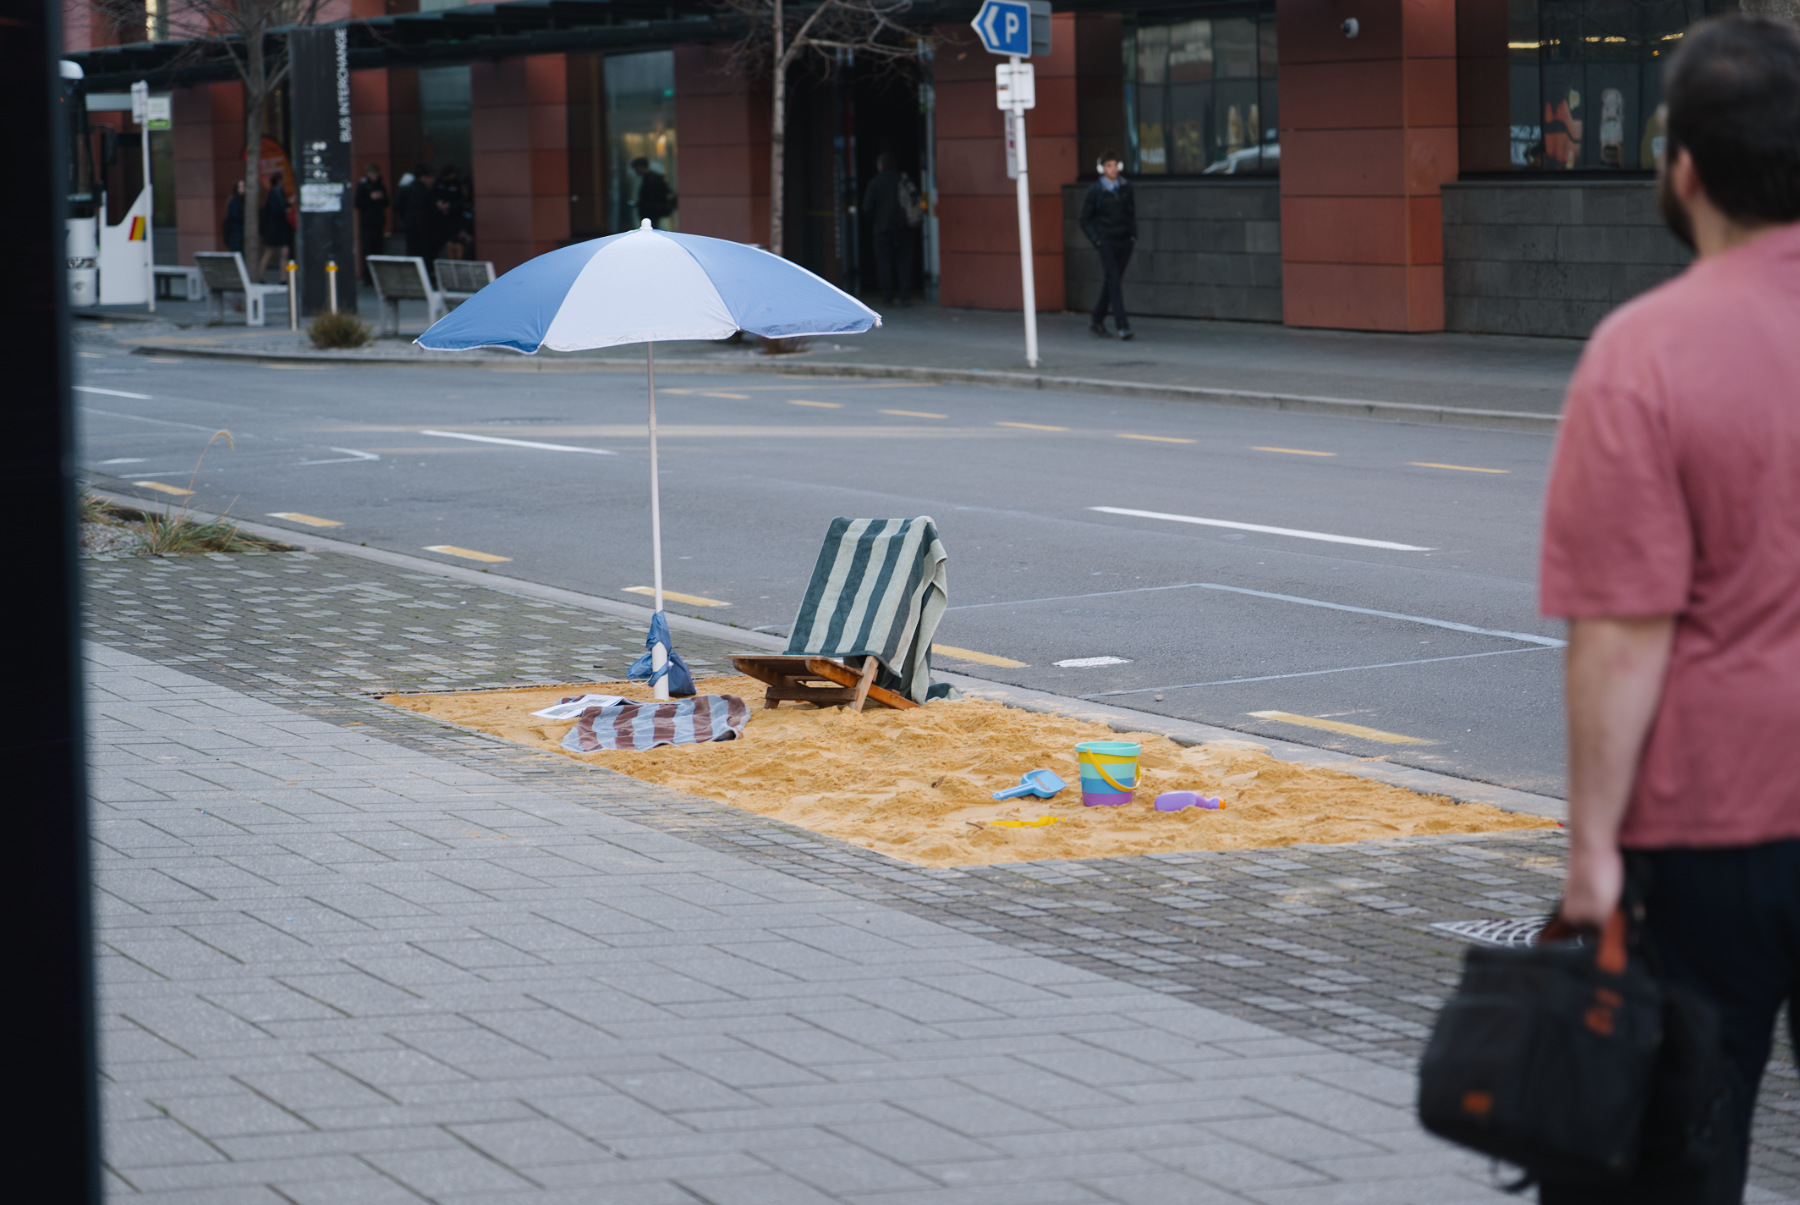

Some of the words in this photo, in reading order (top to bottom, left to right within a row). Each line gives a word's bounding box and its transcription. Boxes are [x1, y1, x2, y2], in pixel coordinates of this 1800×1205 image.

[1006, 12, 1019, 43] P
[335, 28, 350, 115] INTERCHANGE
[339, 116, 352, 142] BUS
